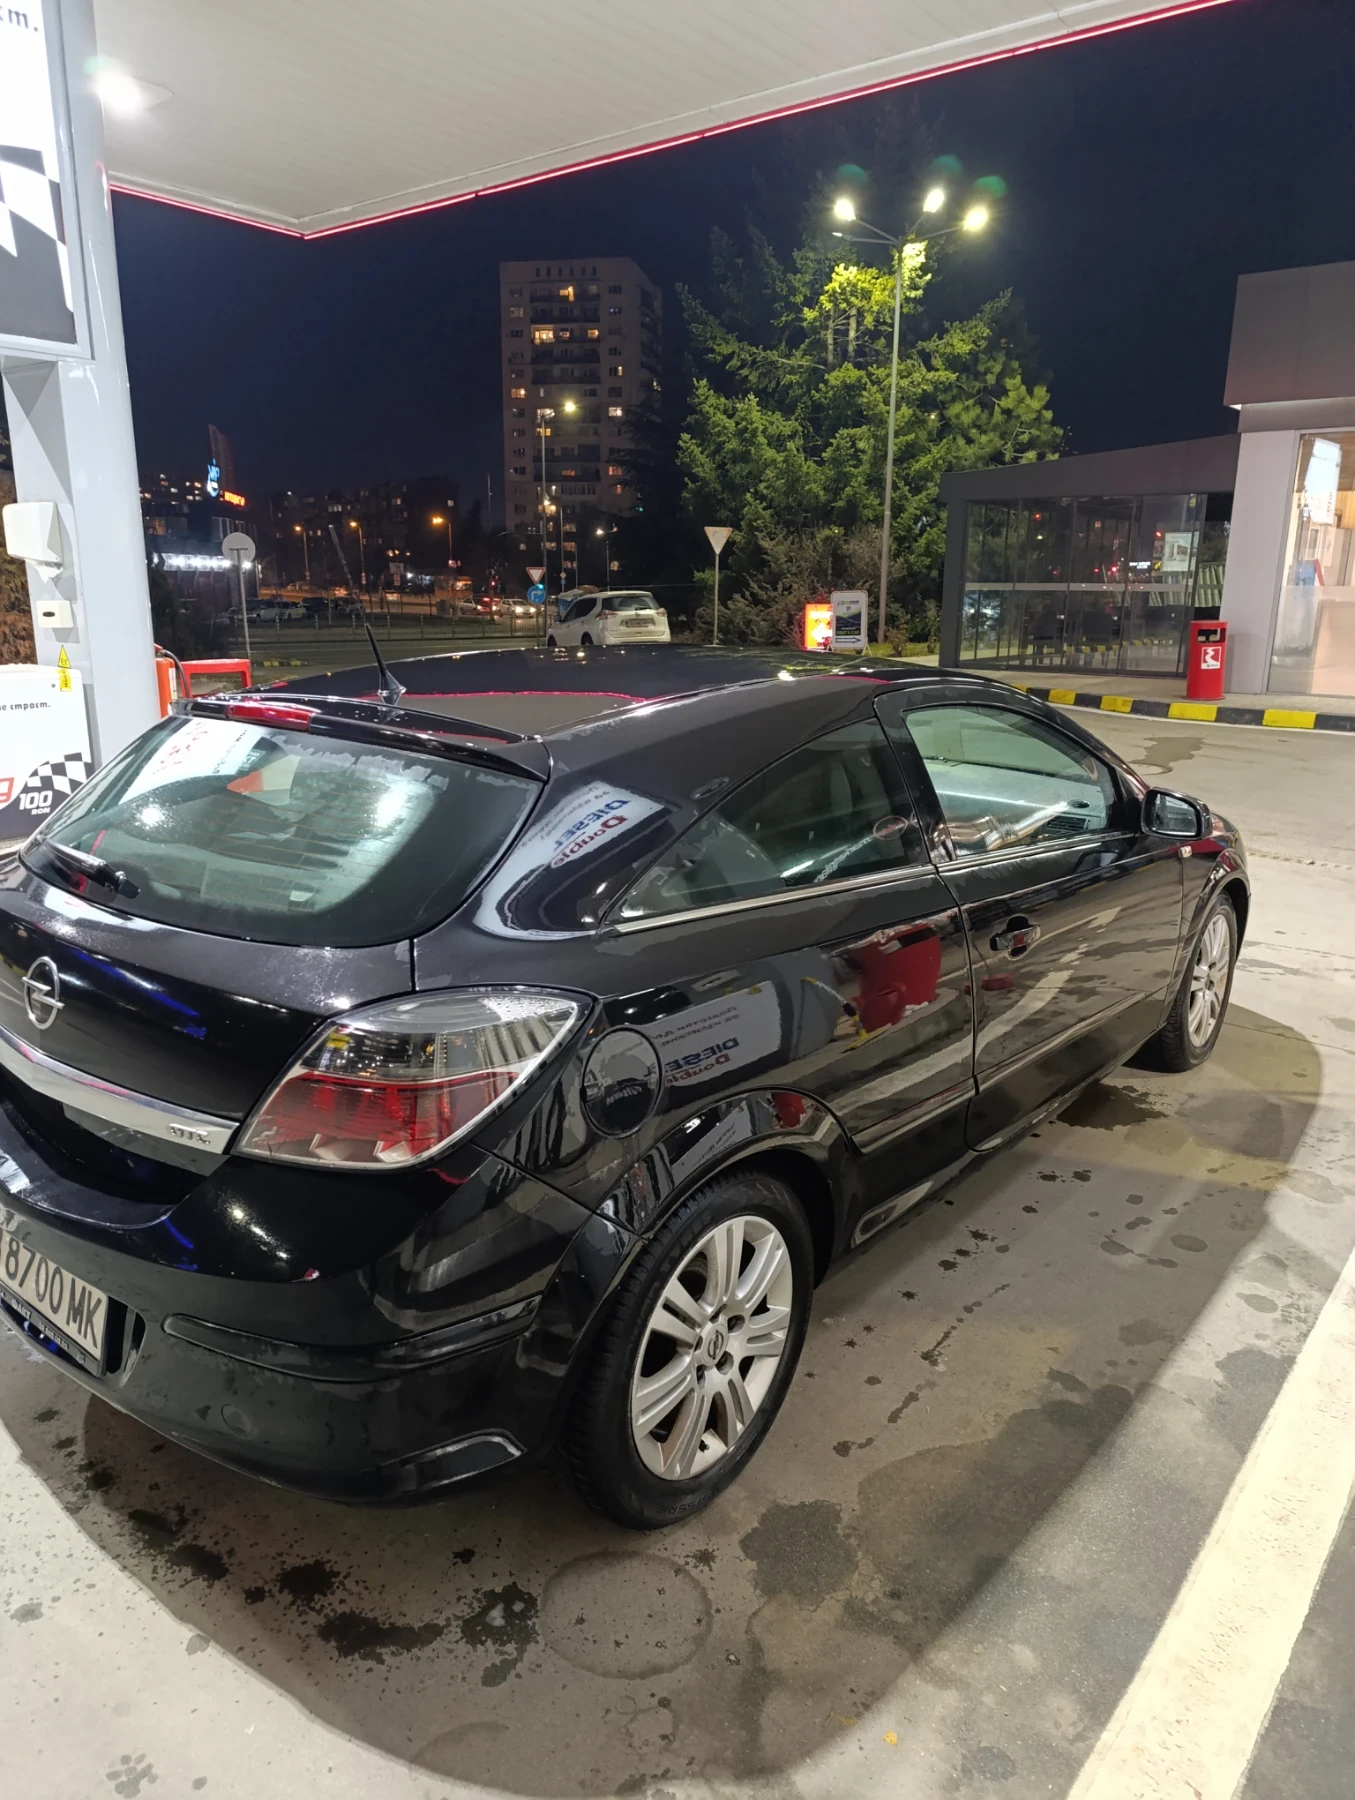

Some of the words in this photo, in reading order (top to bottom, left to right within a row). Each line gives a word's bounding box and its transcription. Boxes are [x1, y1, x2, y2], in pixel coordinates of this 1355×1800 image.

[19, 790, 53, 810] 100
[31, 807, 51, 815] RON
[5, 1236, 63, 1315] 8700
[66, 1277, 102, 1349] MK
